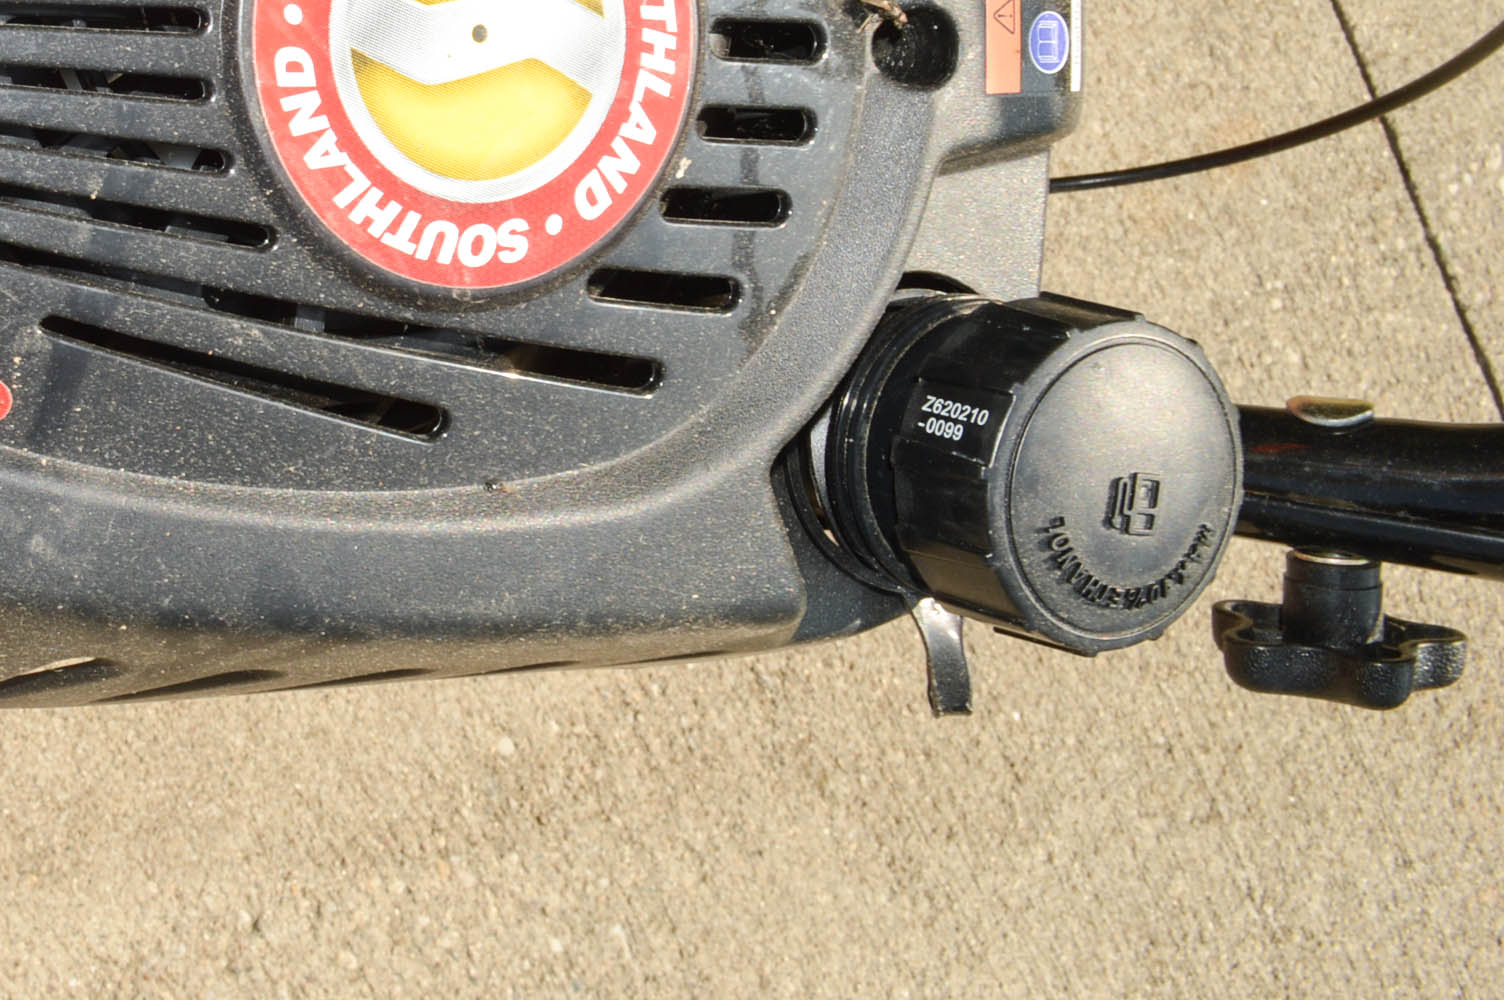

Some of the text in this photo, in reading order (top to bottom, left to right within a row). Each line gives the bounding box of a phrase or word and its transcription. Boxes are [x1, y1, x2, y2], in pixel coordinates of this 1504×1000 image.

[274, 45, 531, 269] SOUTHLAND
[921, 394, 990, 426] Z620210
[917, 417, 964, 441] -0099
